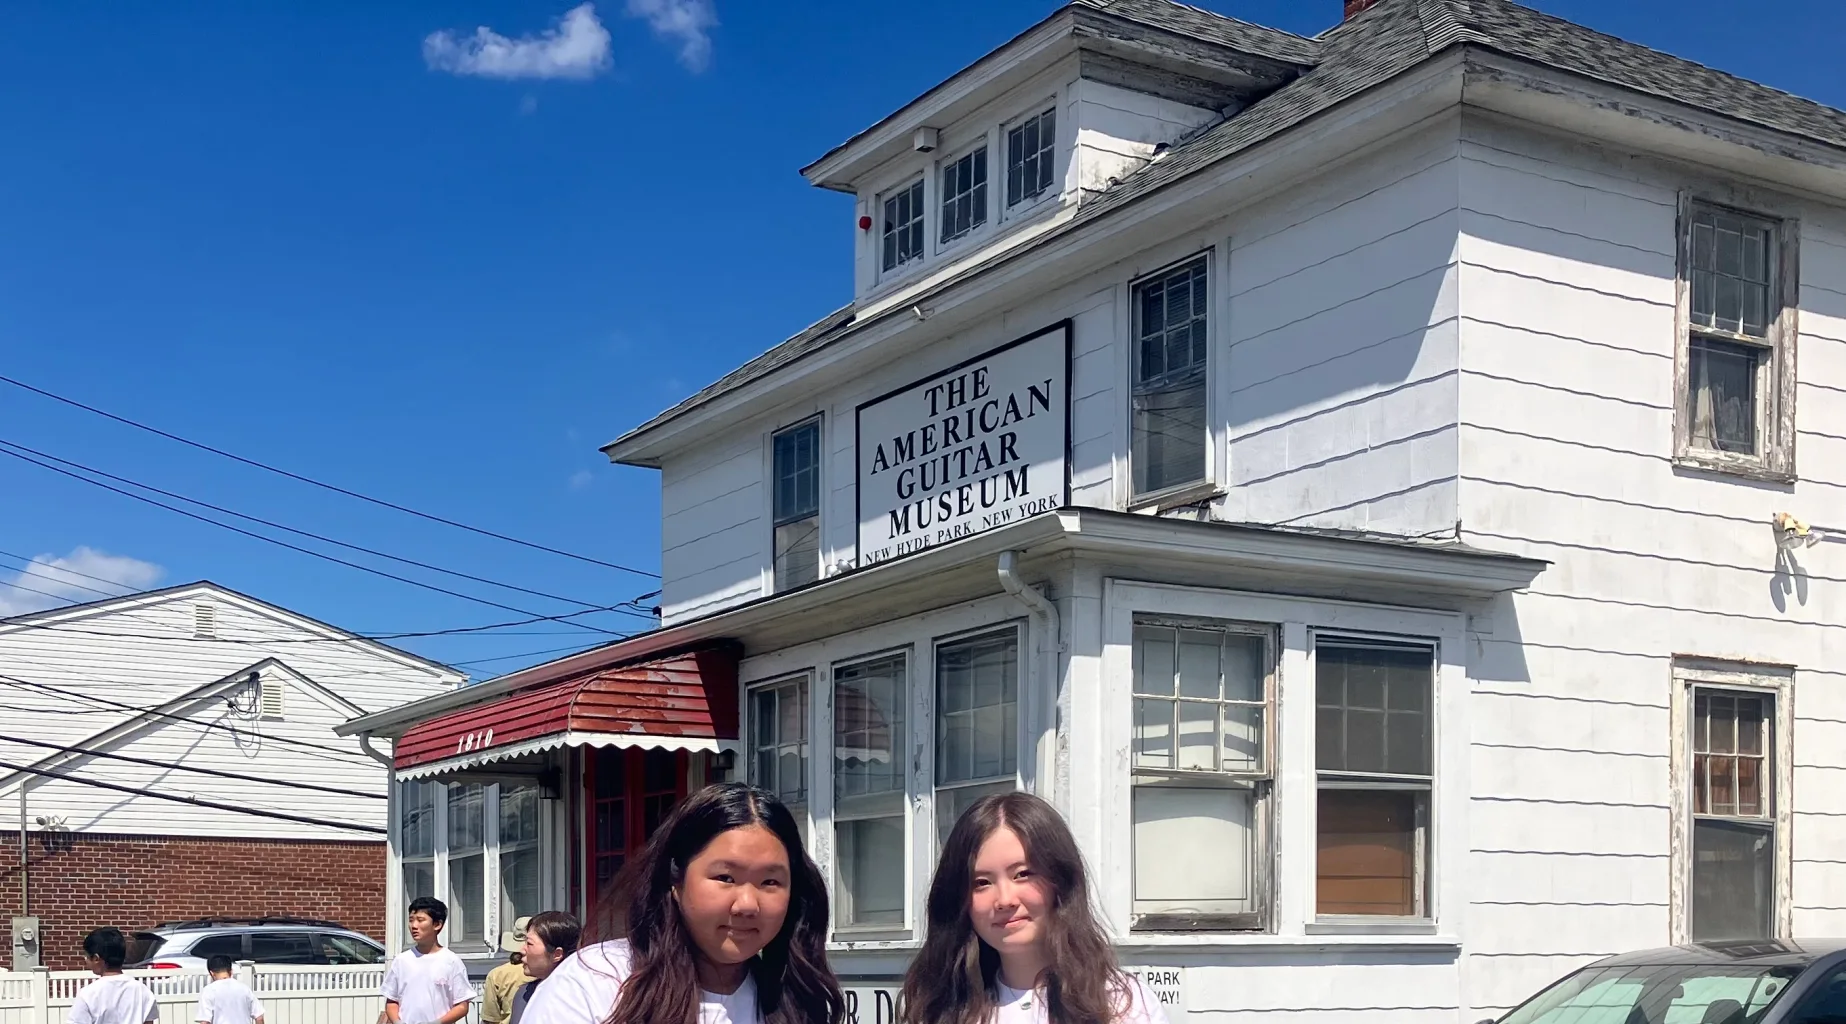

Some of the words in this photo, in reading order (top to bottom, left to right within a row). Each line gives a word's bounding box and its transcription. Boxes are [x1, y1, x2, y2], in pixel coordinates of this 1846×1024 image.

[924, 366, 990, 417] THE
[871, 379, 1052, 475] AMERICAN
[897, 431, 1020, 500] GUITAR
[865, 546, 891, 565] NEW
[897, 535, 931, 557] HYDE
[982, 508, 1013, 530] NEW
[1019, 494, 1058, 518] YORK
[888, 464, 1029, 539] MUSEUM
[456, 728, 493, 754] 1810
[1147, 971, 1180, 985] PARK
